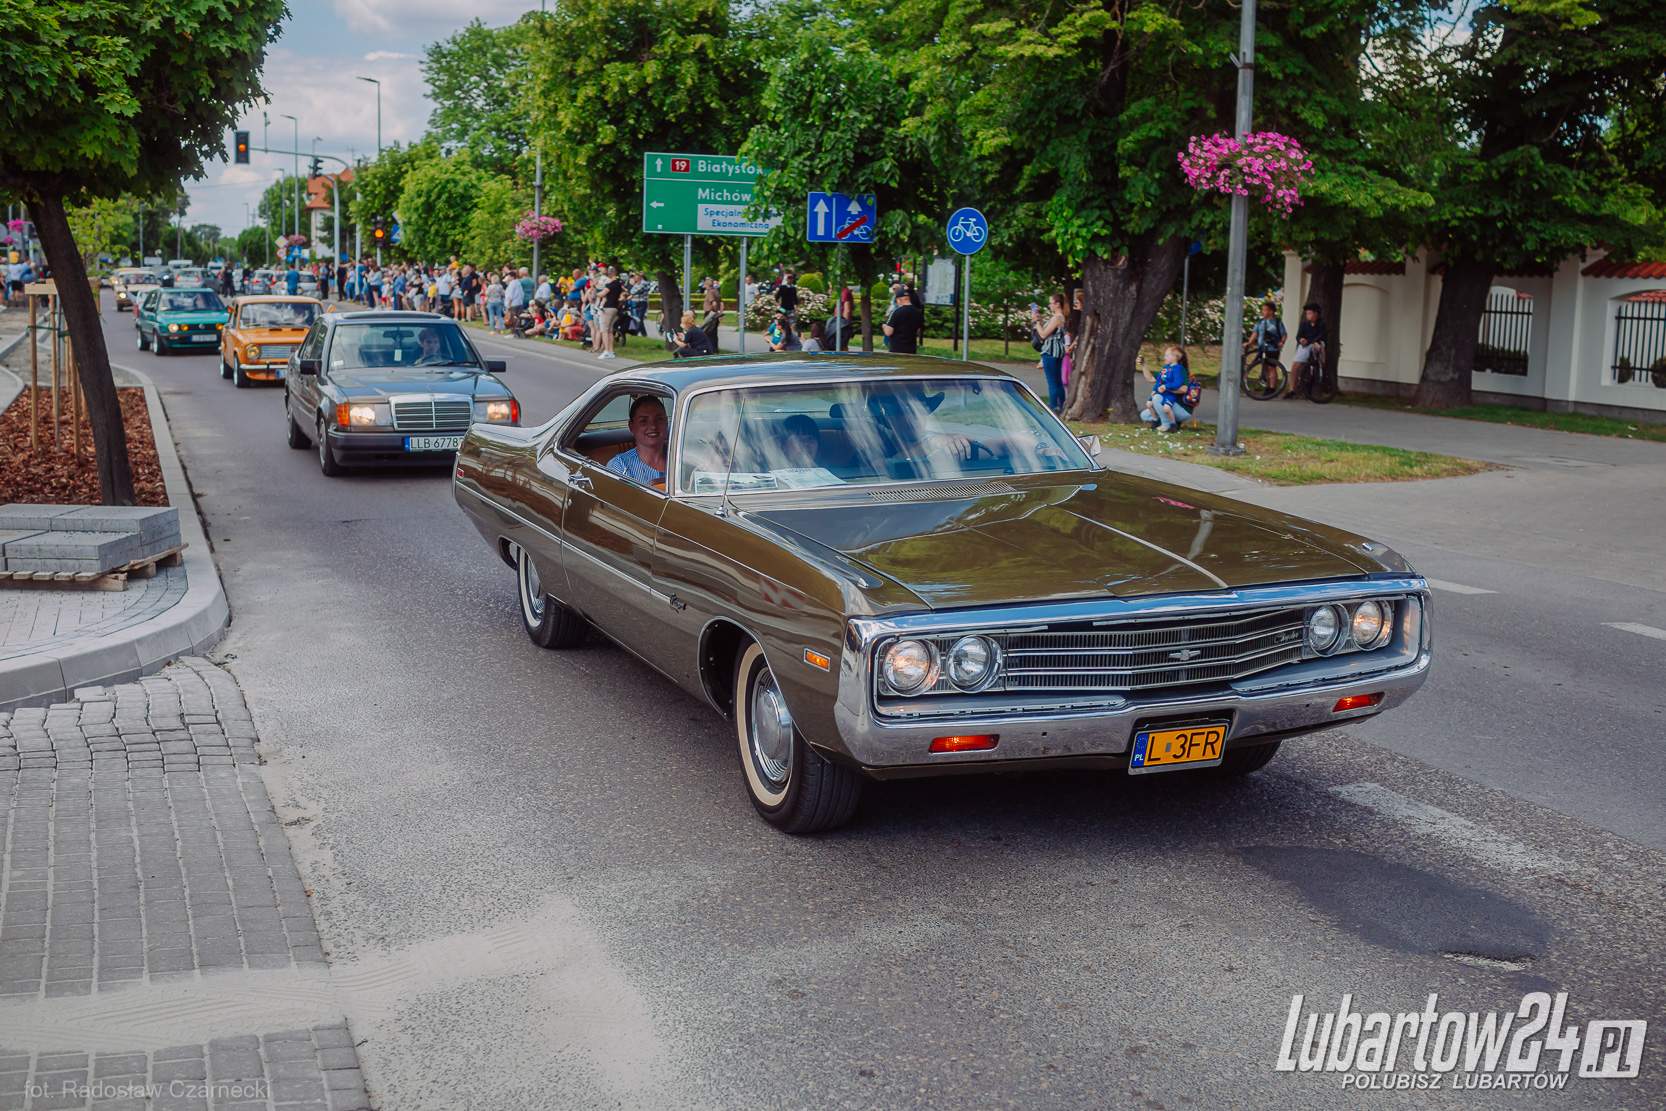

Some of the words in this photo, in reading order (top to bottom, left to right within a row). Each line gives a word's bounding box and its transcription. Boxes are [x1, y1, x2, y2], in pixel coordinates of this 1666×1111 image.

[675, 160, 687, 171] 19
[697, 188, 751, 201] Michów
[433, 437, 464, 448] 6778
[1172, 730, 1220, 759] 3FR
[1134, 753, 1144, 762] PL
